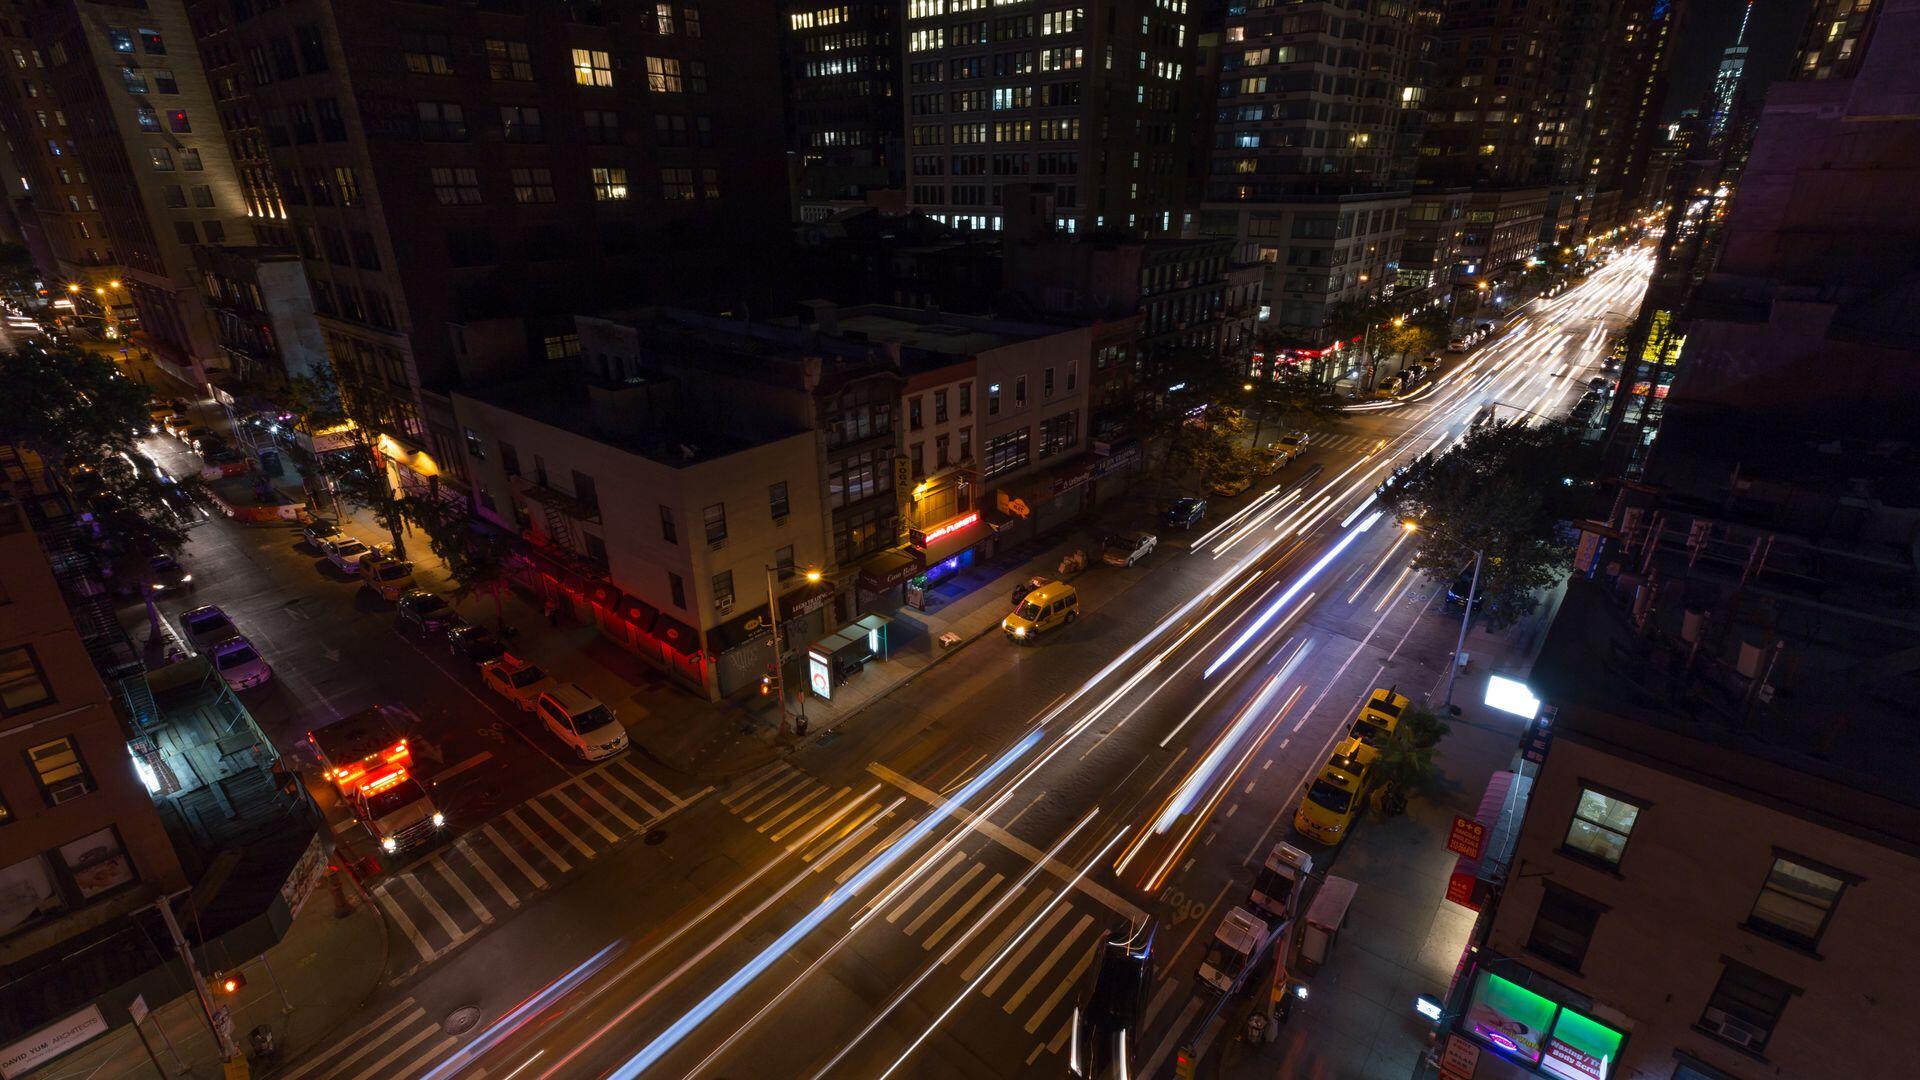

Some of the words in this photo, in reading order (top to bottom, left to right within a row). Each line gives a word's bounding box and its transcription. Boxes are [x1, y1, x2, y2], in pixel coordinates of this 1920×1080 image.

[899, 460, 907, 486] YOGA
[1457, 818, 1482, 835] 6+6
[2, 1053, 27, 1068] DAVID
[29, 1042, 49, 1055] YUM
[52, 1017, 98, 1045] ARCHITECTS
[1551, 1039, 1583, 1061] Waxing
[1552, 1048, 1576, 1064] Body
